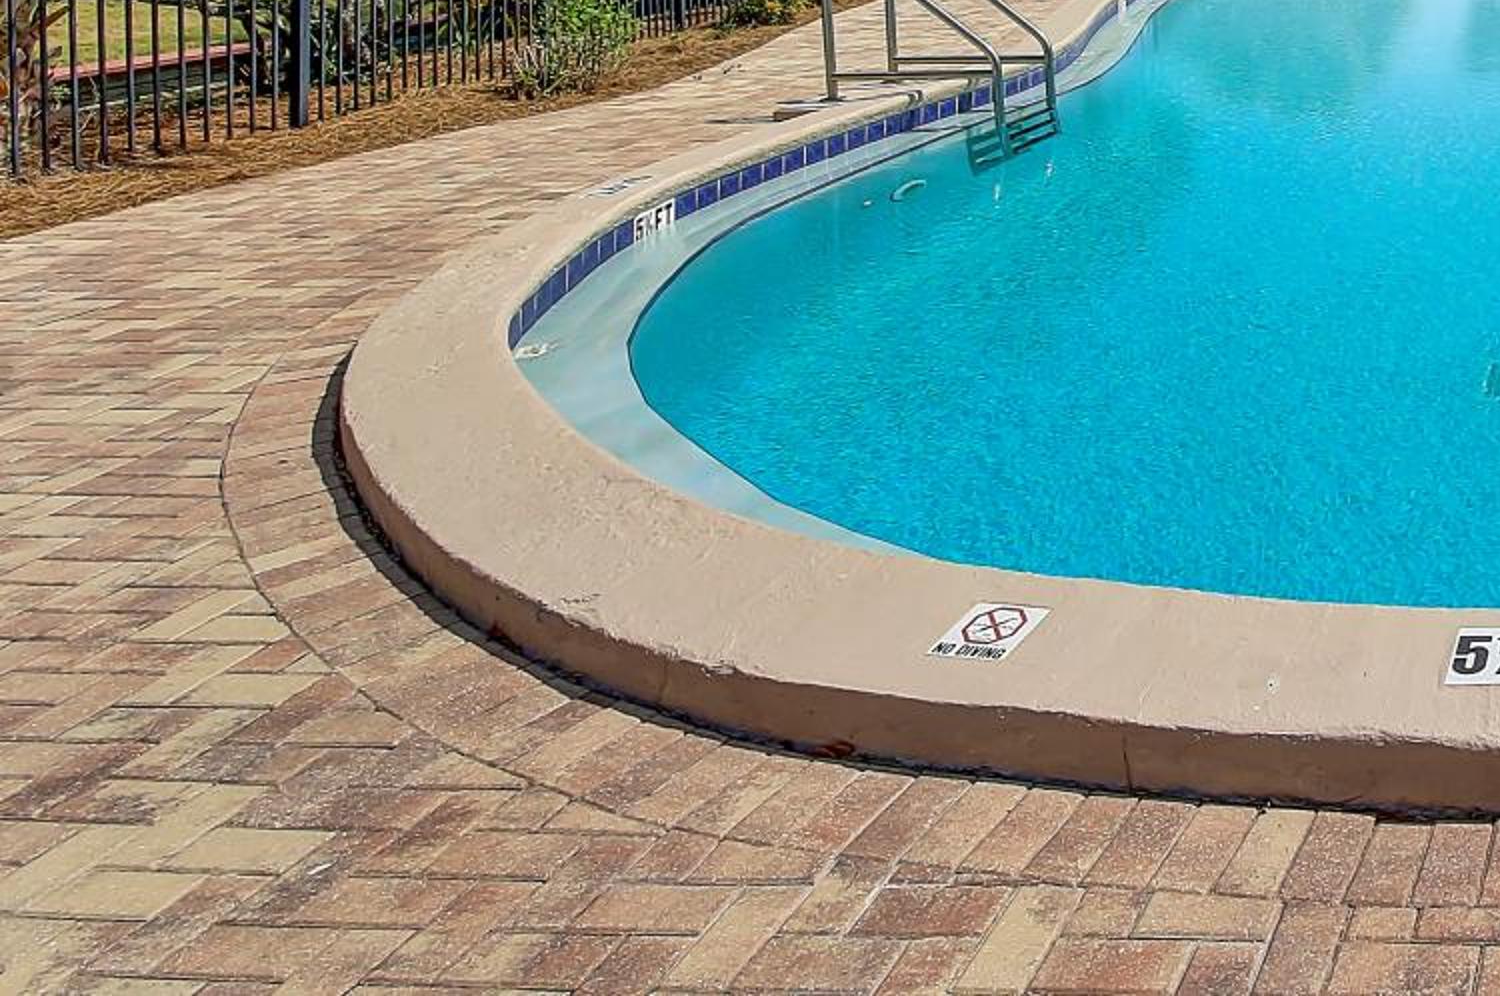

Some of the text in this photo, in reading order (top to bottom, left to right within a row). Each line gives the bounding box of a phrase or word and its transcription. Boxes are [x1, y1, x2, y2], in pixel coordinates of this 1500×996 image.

[655, 202, 673, 231] FT
[931, 642, 1007, 659] NO DIVING
